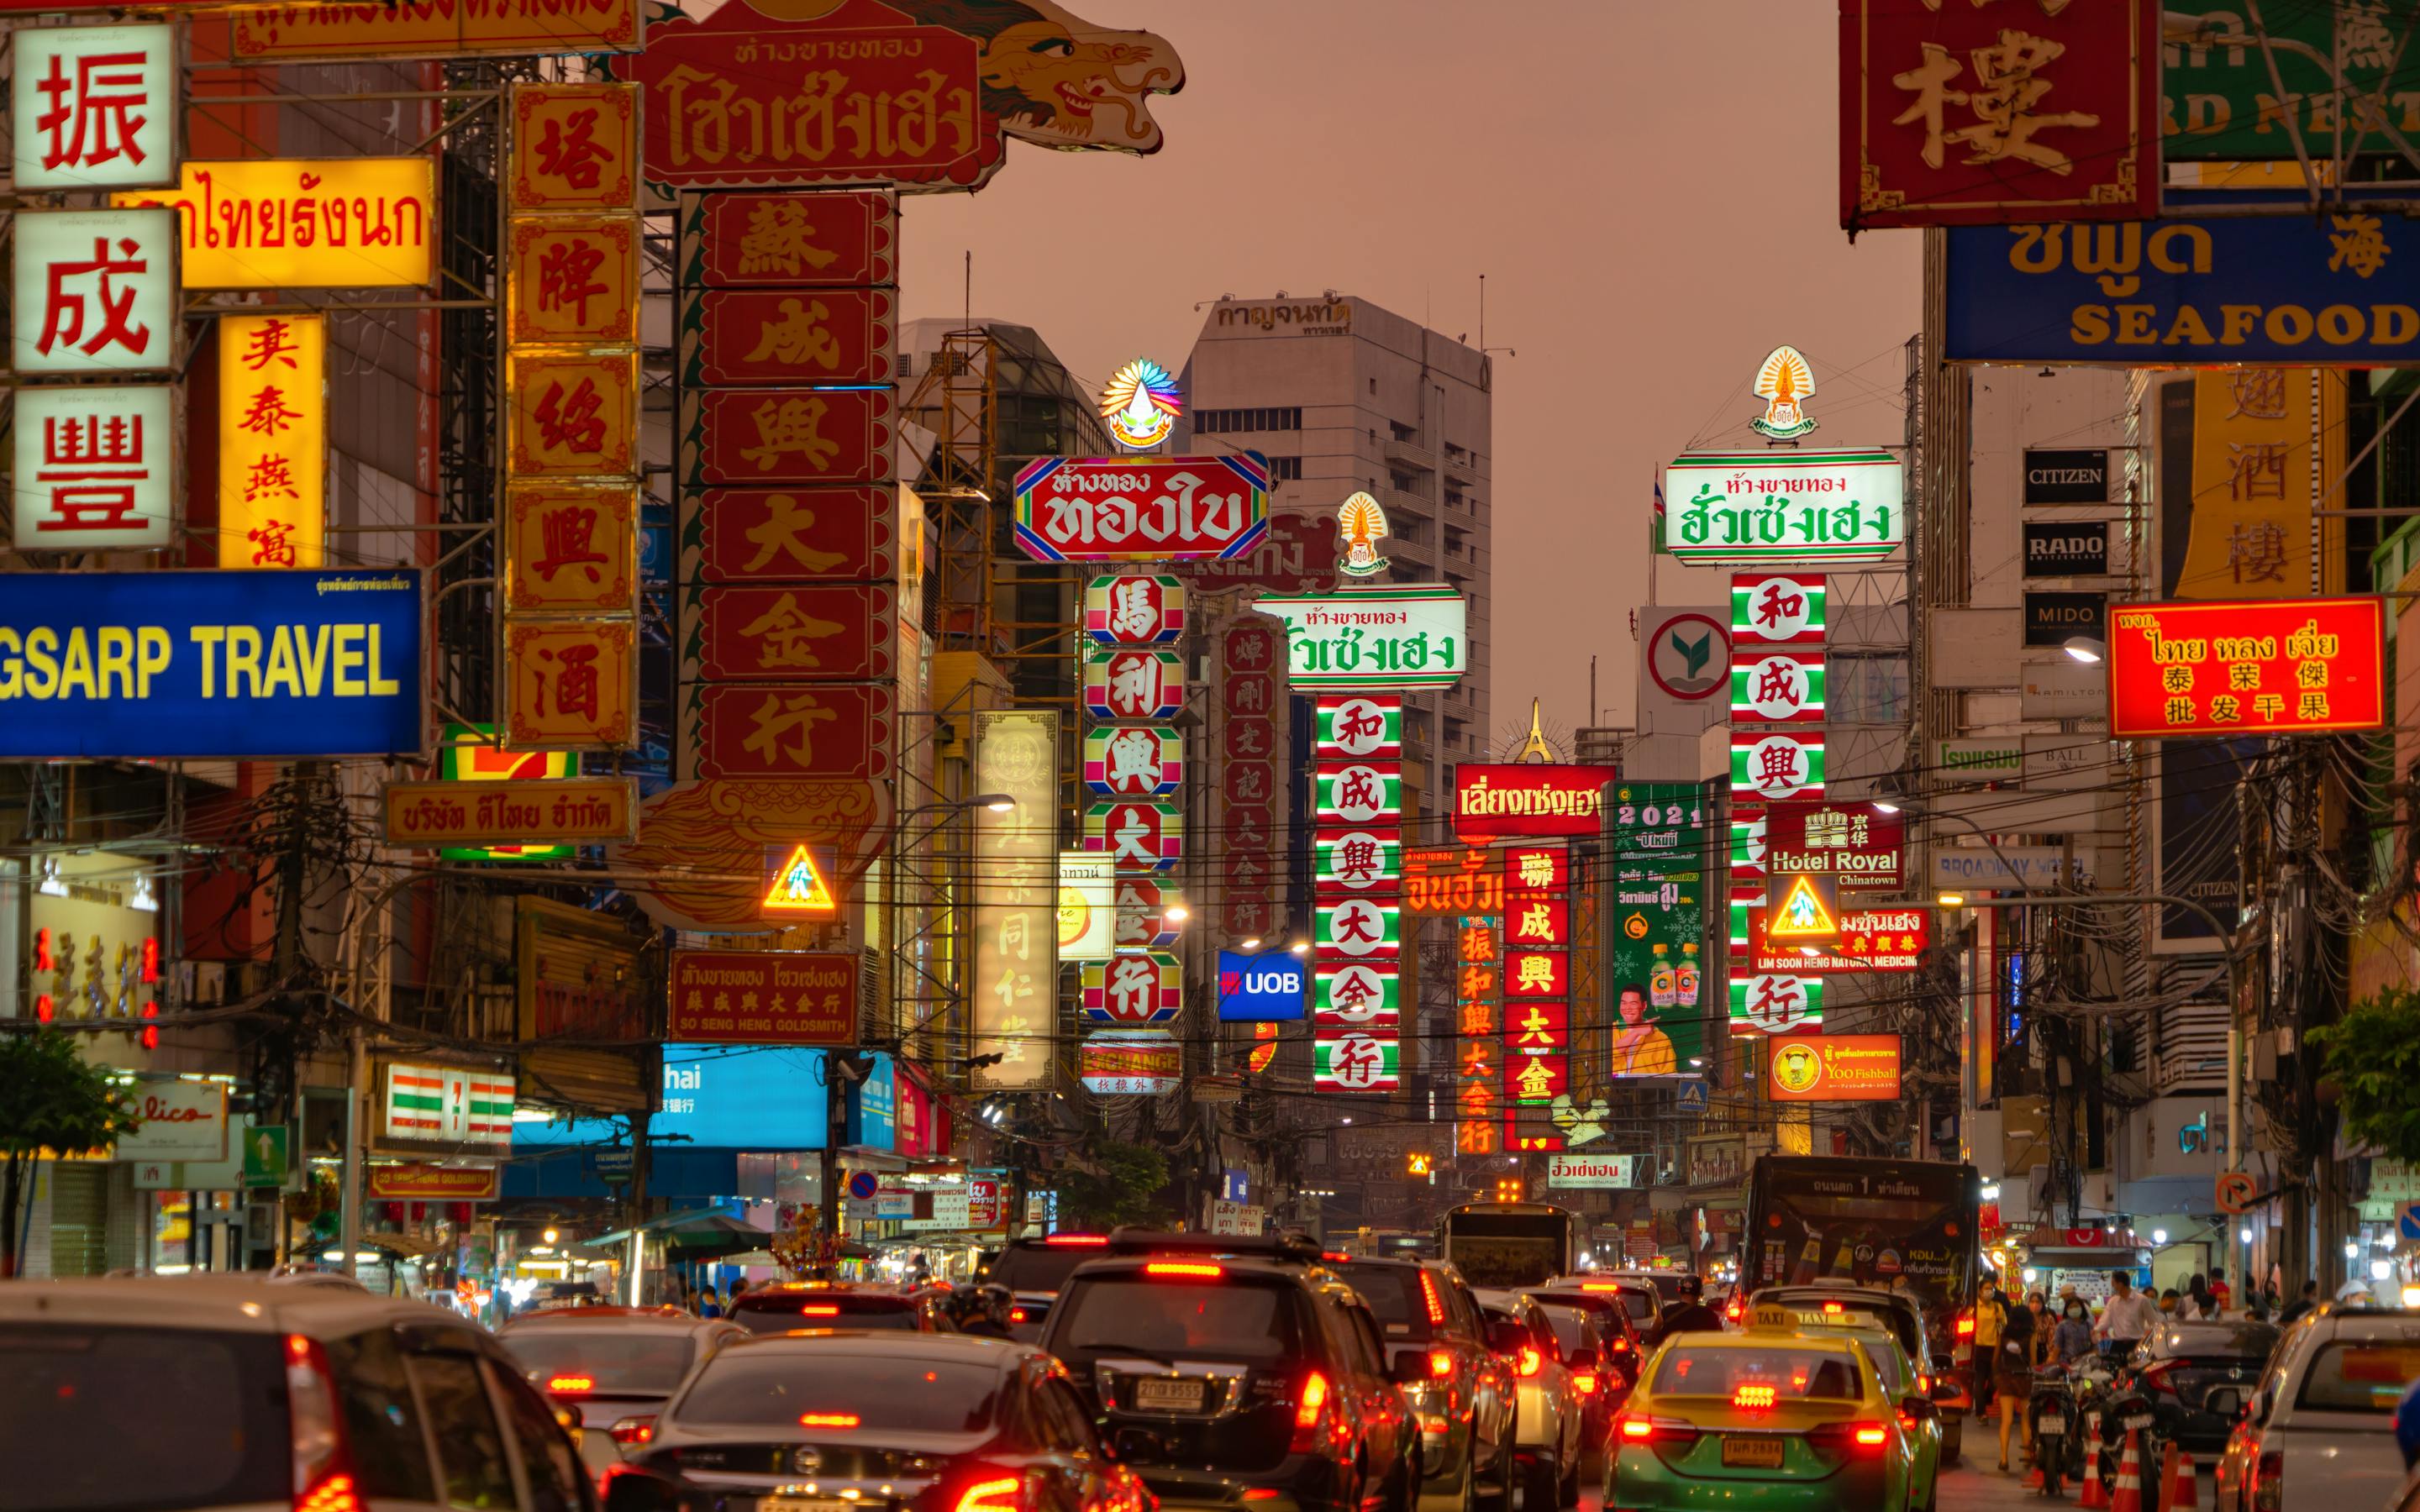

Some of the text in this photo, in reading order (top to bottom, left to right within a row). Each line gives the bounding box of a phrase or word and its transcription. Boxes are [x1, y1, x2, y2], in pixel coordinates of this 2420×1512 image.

[734, 35, 923, 64] ห้างขายทอง
[2328, 214, 2391, 278] 海
[35, 50, 150, 531] 振成豐
[1302, 323, 1352, 335] ทาวเวอร์
[2070, 304, 2420, 344] SEAFOOD
[1052, 466, 1151, 492] ห้างทอง
[1726, 472, 1846, 494] ห้างขายทอง
[2029, 468, 2102, 485] CITIZEN
[1044, 471, 1243, 544] ทองใบ
[1680, 483, 1890, 544] ฮั่วเซ่งเฮง
[2030, 537, 2103, 555] RADO
[1306, 606, 1407, 625] ห้างขายทอง
[2039, 607, 2093, 622] MIDO
[2119, 614, 2160, 628] หจก.
[1284, 617, 1455, 672] ั่วเซ่งเฮง
[2145, 620, 2338, 662] ไทย หลง เจี่ย
[190, 623, 400, 697] TRAVEL
[2046, 750, 2088, 761] BALL
[402, 792, 613, 831] บริษัท ดีไทย จำกัด
[1750, 586, 1810, 1026] 和成興行
[1618, 806, 1703, 828] 2021
[1850, 814, 1869, 848] 京华
[1773, 850, 1897, 871] Hotel Royal
[2037, 857, 2084, 874] HOEL
[1839, 874, 1897, 885] Chinatown
[2188, 882, 2238, 897] CITIZEN
[1334, 706, 1383, 1085] 和成興大金行
[1840, 911, 1920, 938] มซุ่นเฮง
[1758, 958, 1774, 969] LIM
[1776, 957, 1802, 969] SOON
[1804, 956, 1830, 969] HENG
[1875, 954, 1918, 967] MEDICIN
[681, 963, 765, 984] ห้างขายทอง
[1245, 973, 1300, 995] UOB
[1516, 853, 1556, 1150] 聯成興大金
[680, 1017, 846, 1032] SO SENG HENG GOLDSMITH
[1083, 1052, 1178, 1071] EXCHANGE
[1855, 1068, 1897, 1079] Fishball
[441, 1173, 487, 1184] GOLDSMITH
[1814, 1180, 1853, 1193] ถนนตก
[1861, 1177, 1869, 1194] 1
[1758, 1312, 1785, 1325] TAXI
[1802, 1312, 1828, 1324] TAXI
